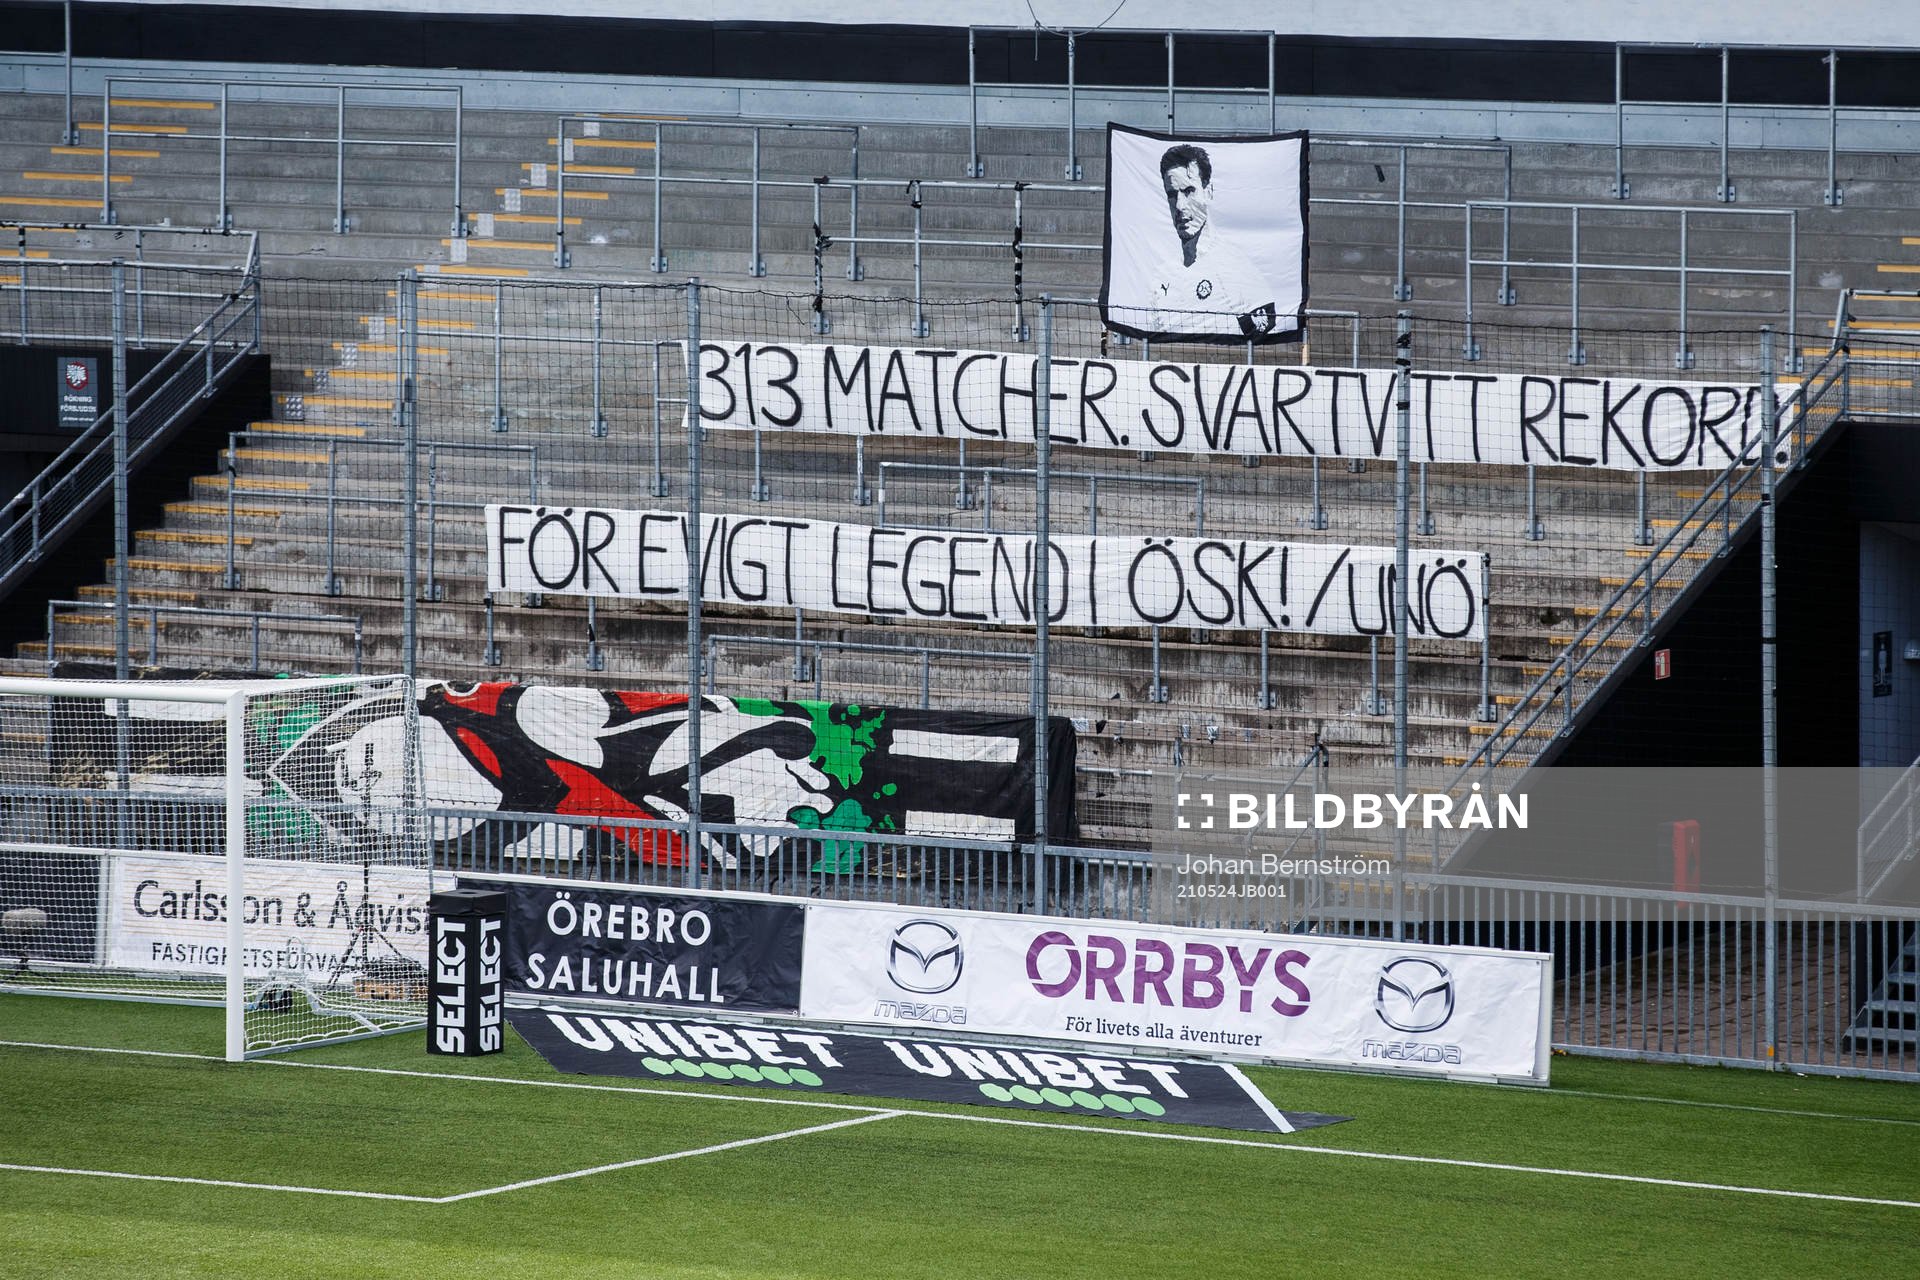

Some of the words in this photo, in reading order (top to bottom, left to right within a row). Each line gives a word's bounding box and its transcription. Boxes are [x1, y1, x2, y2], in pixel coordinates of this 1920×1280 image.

[698, 343, 801, 427] 313
[823, 346, 1129, 447] MATCHER.
[1141, 364, 1498, 463] SVARTVTT
[499, 506, 619, 594] FÖR
[638, 514, 810, 606] EVIGT
[832, 524, 1069, 623] LEGEND
[1127, 537, 1292, 629] ÖSK!
[293, 891, 317, 928] &
[547, 891, 711, 946] ÖREBRO
[436, 917, 467, 1055] SELECT
[479, 918, 501, 1054] SELECT
[526, 953, 725, 1003] SALUHALL
[1026, 931, 1311, 1017] ORRBYS
[546, 1014, 843, 1068] UNIBET
[1065, 1016, 1092, 1034] För
[1096, 1017, 1140, 1038] livets
[1146, 1022, 1174, 1041] alla
[1180, 1025, 1262, 1047] äventurer
[883, 1040, 1189, 1099] UNIBET
